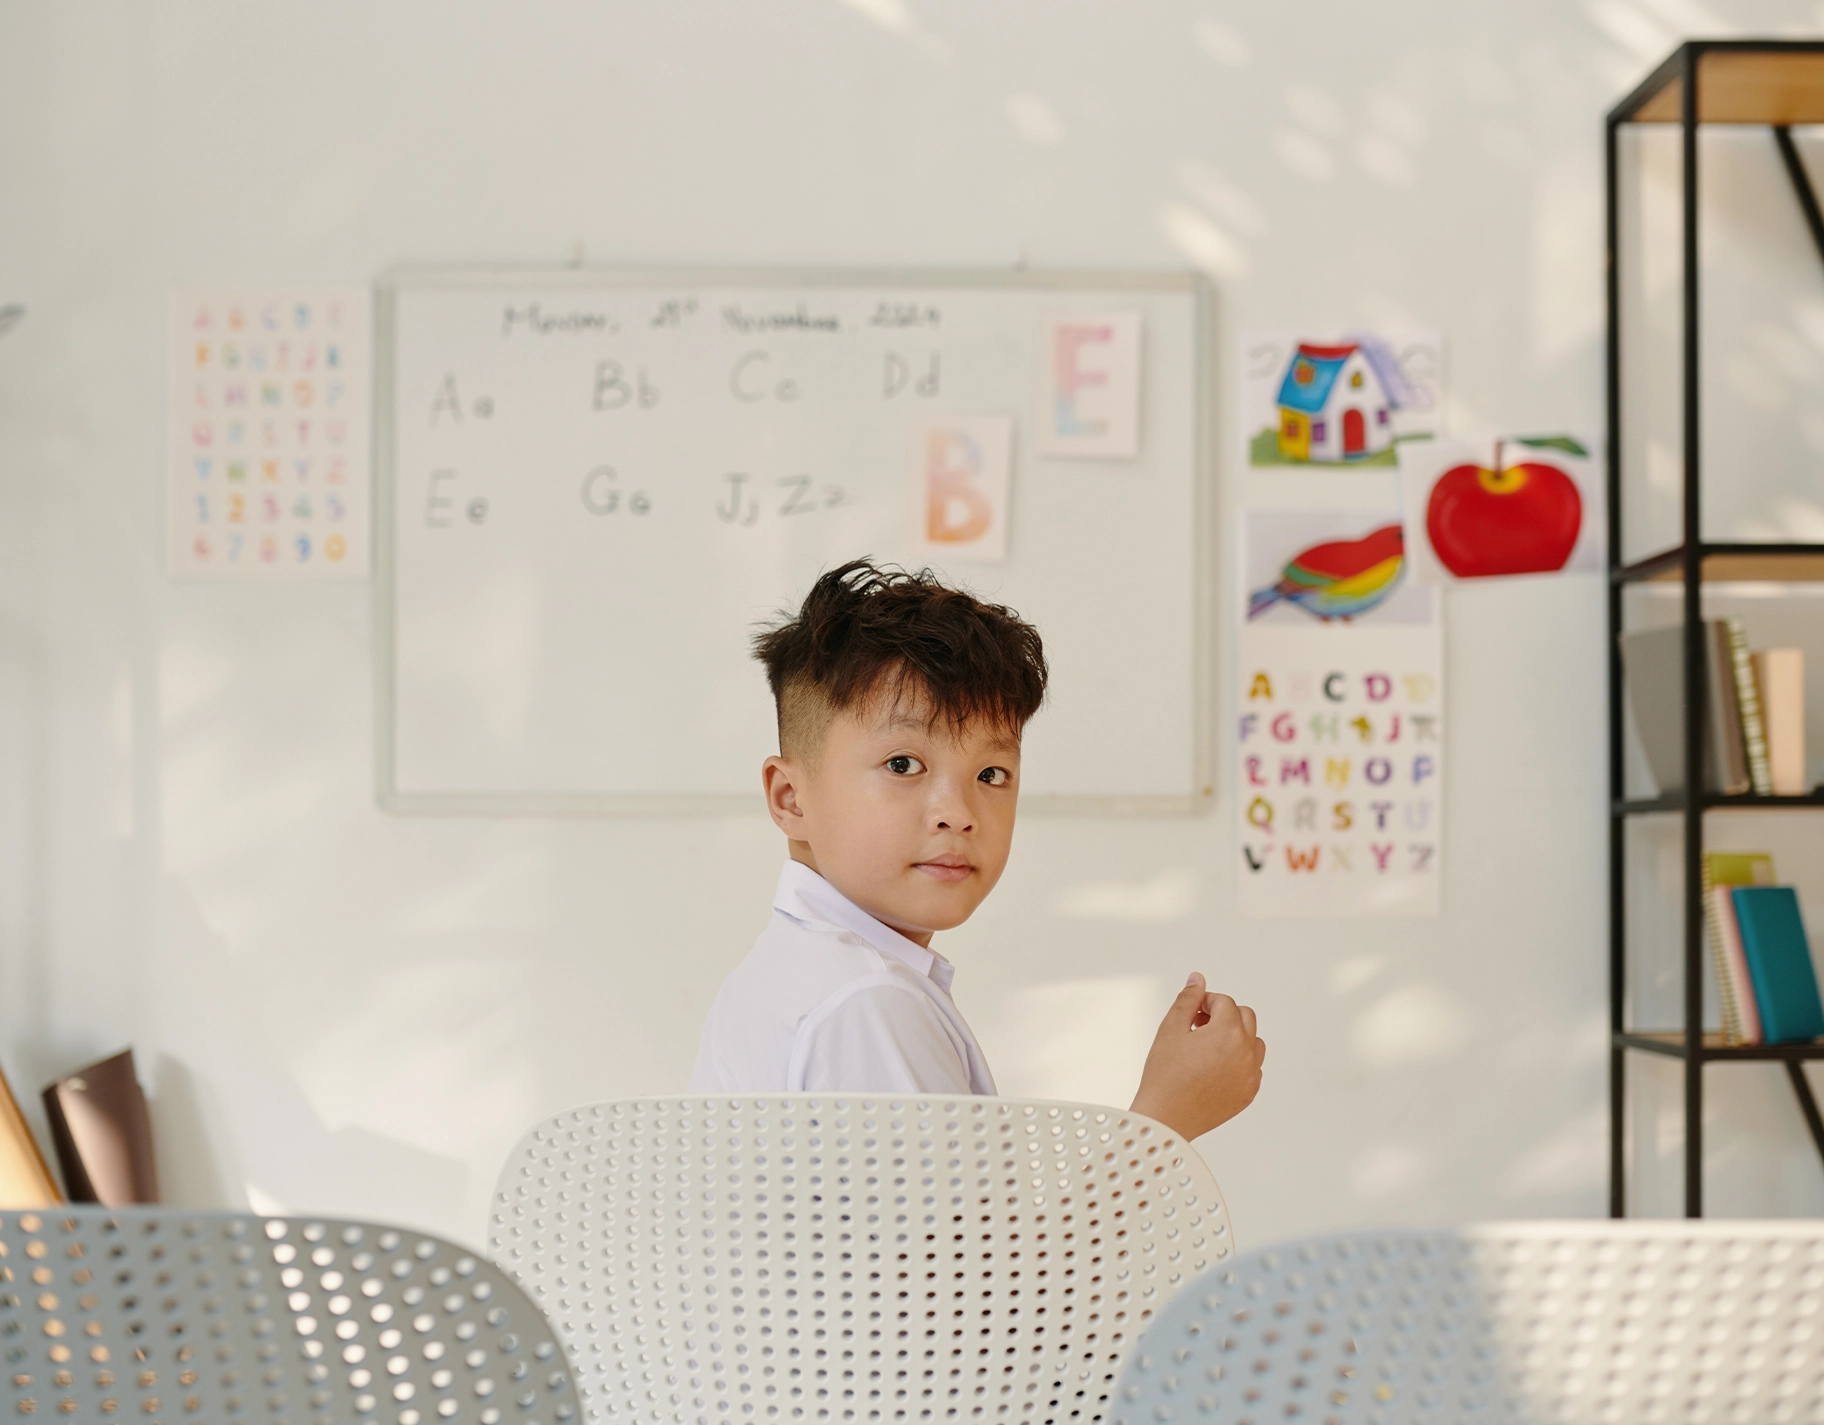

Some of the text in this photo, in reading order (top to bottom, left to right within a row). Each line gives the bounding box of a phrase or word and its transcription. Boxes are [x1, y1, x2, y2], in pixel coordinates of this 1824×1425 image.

[591, 360, 660, 412] Bb
[882, 351, 941, 400] Dd
[1053, 322, 1114, 438] E
[425, 469, 489, 528] Ee
[924, 428, 994, 545] B
[228, 493, 245, 524] 2
[1249, 672, 1273, 701] A
[1322, 672, 1346, 703] C
[1363, 673, 1393, 702] D
[1237, 713, 1258, 742] F
[1270, 712, 1297, 743] G
[1387, 715, 1401, 743] J
[1280, 756, 1310, 786] M
[1246, 795, 1275, 834] Q
[1332, 802, 1353, 831] S
[1369, 802, 1394, 830] T
[1285, 846, 1320, 872] W
[1370, 844, 1394, 873] Y
[1409, 844, 1434, 871] Z
